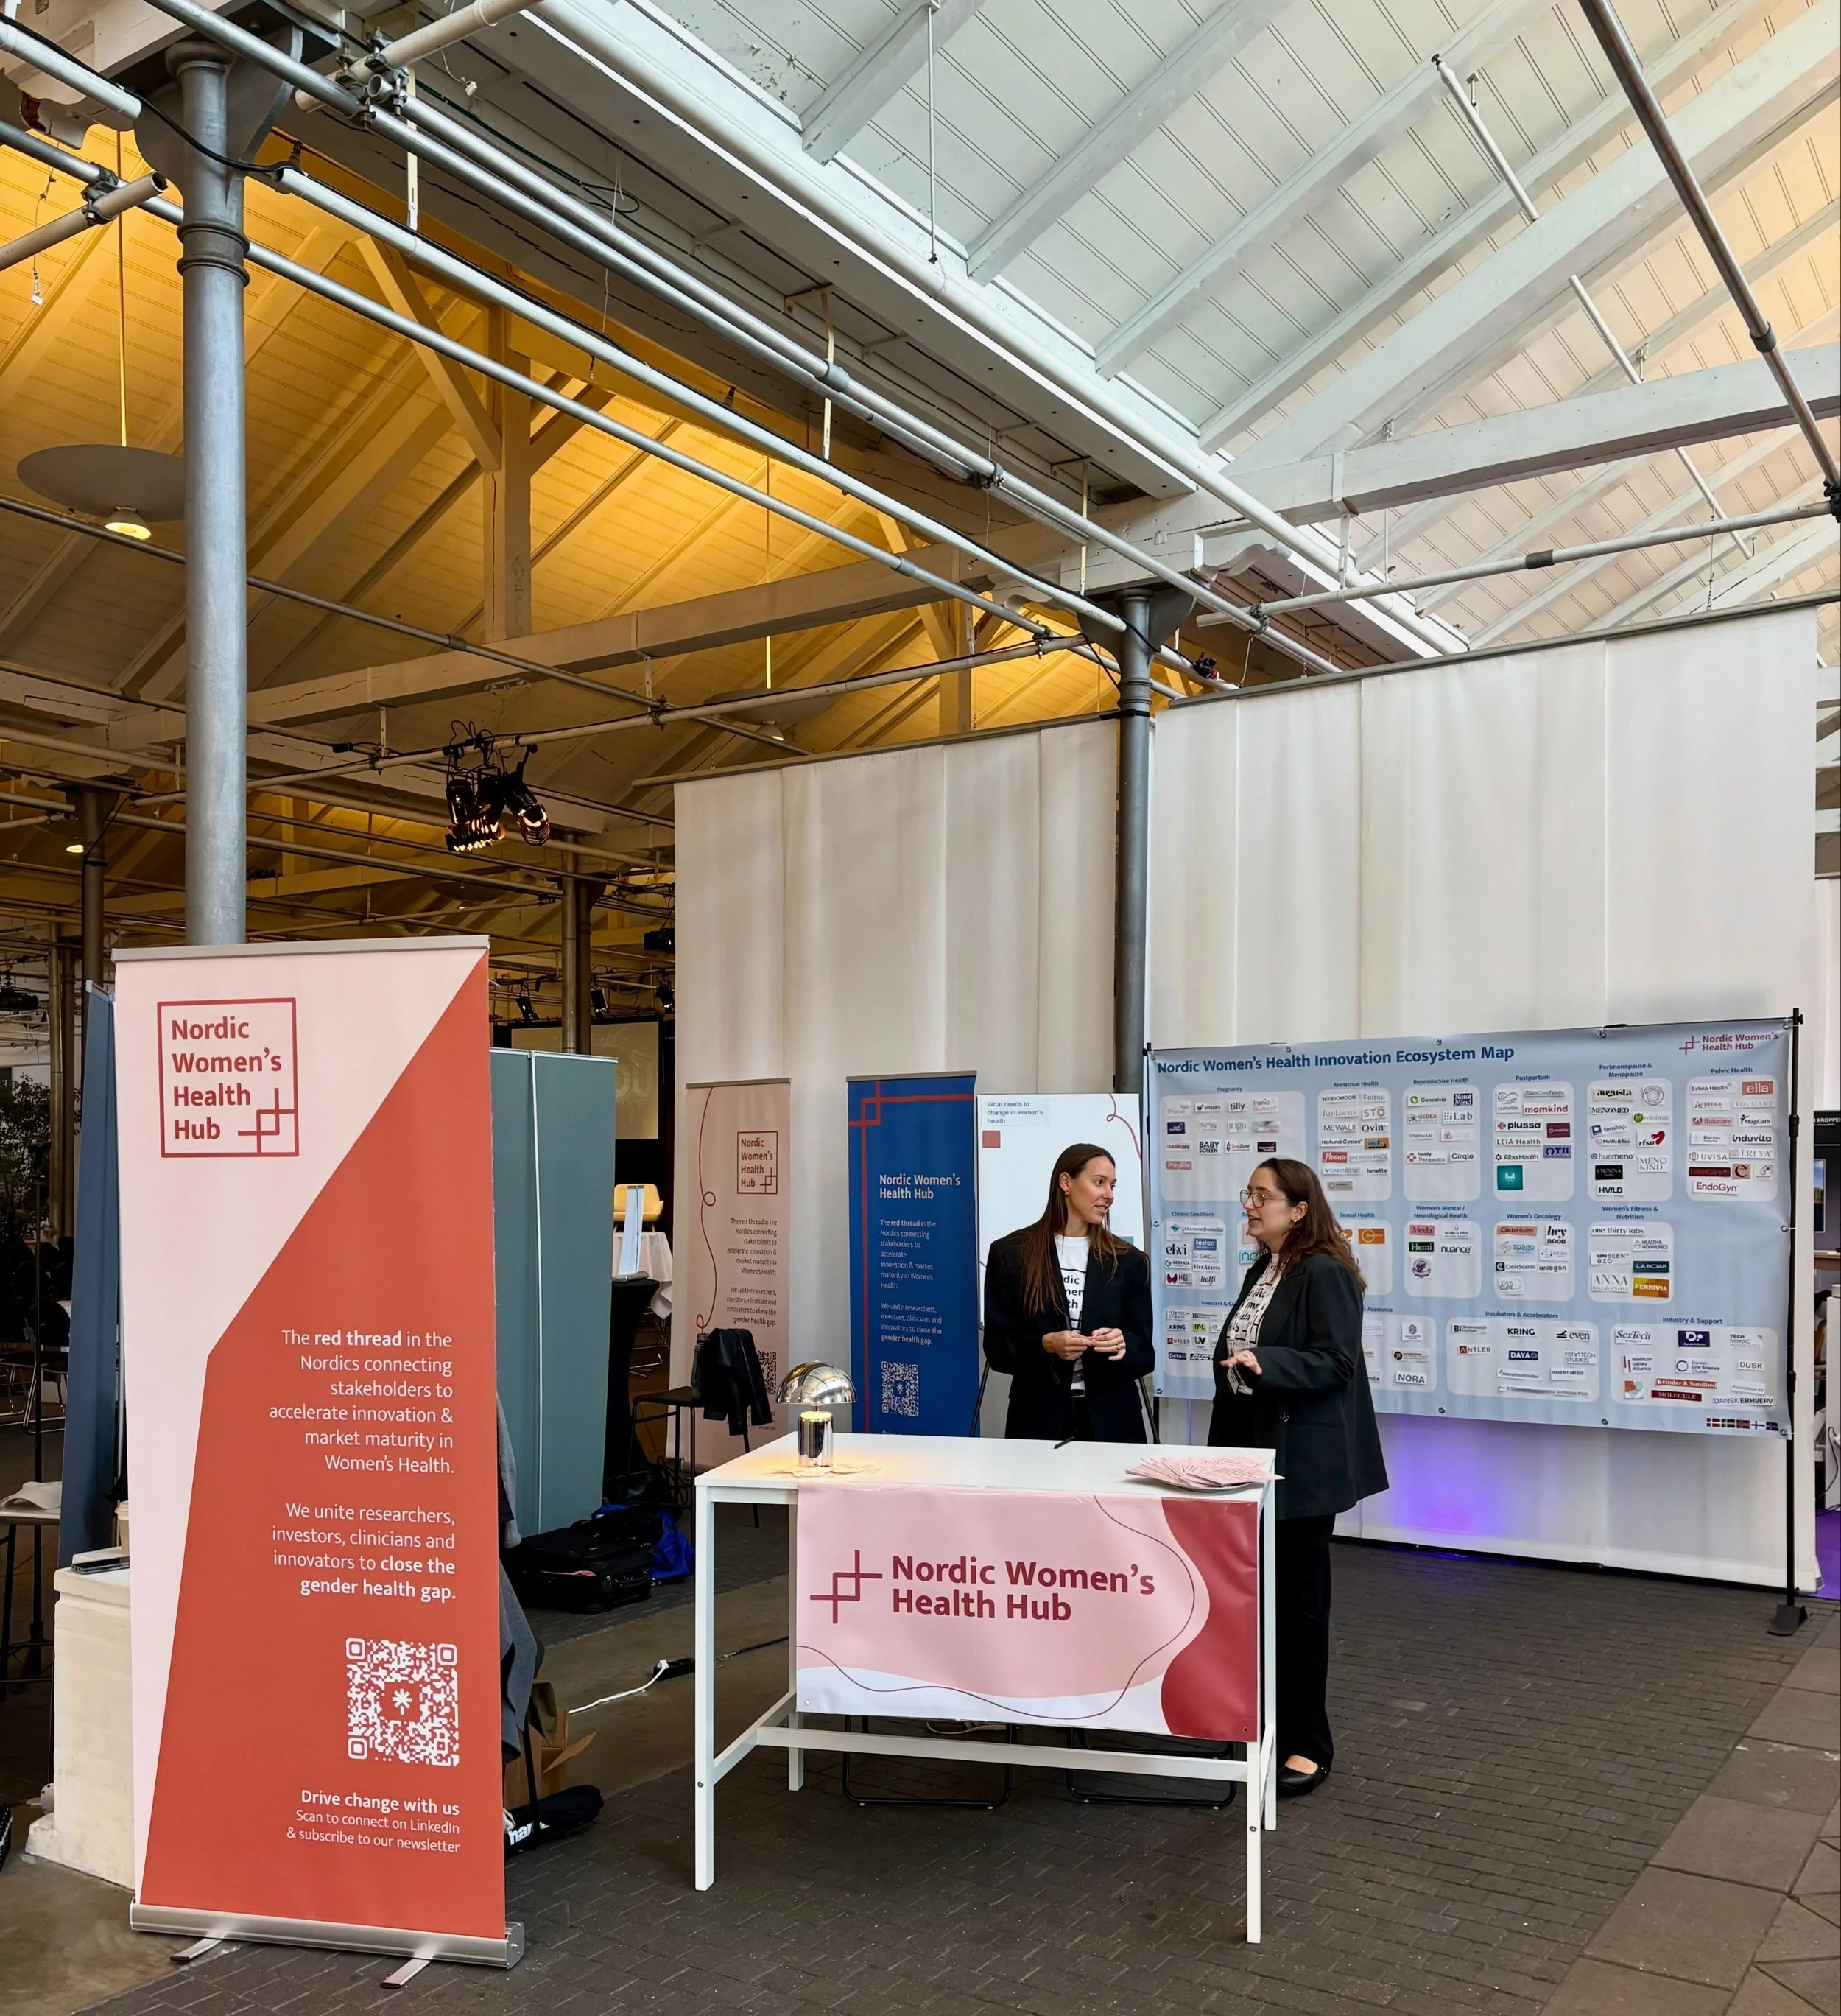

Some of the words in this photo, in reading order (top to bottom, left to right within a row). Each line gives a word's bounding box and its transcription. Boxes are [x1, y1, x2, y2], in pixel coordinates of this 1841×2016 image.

[172, 1015, 250, 1040] Nordic
[1702, 1034, 1733, 1043] Nordic
[1702, 1043, 1733, 1051] Health
[1735, 1042, 1754, 1050] Hub
[172, 1047, 282, 1073] Women’s
[1158, 1059, 1200, 1074] Nordic
[1203, 1056, 1262, 1072] Women’s
[1266, 1054, 1311, 1069] Health
[1314, 1050, 1392, 1067] Innovation
[1396, 1048, 1476, 1066] Ecosystem
[1481, 1047, 1515, 1062] Map
[1413, 1078, 1449, 1086] Reproductive
[174, 1082, 251, 1106] Health
[1747, 1083, 1769, 1094] ella
[1364, 1106, 1385, 1117] STÖ
[1524, 1104, 1569, 1114] momkind
[175, 1116, 221, 1140] Hub
[741, 1137, 764, 1148] Nordic
[1732, 1134, 1772, 1142] induvita
[741, 1165, 764, 1175] Health
[741, 1177, 756, 1188] Hub
[880, 1174, 911, 1186] Nordic
[913, 1173, 961, 1186] Women’s
[880, 1187, 911, 1199] Health
[915, 1187, 934, 1199] Hub
[1414, 1212, 1448, 1221] Neurological
[901, 1219, 921, 1227] thread
[926, 1220, 936, 1228] the
[900, 1230, 930, 1240] connecting
[1411, 1243, 1433, 1251] Hemi
[1513, 1244, 1535, 1252] spago
[1662, 1316, 1689, 1324] Industry
[1696, 1317, 1723, 1325] Support
[1507, 1327, 1535, 1335] KRING
[1569, 1332, 1590, 1340] even
[282, 1329, 310, 1345] The
[315, 1330, 342, 1346] red
[346, 1330, 402, 1346] thread
[407, 1331, 420, 1347] in
[425, 1332, 452, 1348] the
[881, 1334, 901, 1342] gender
[901, 1334, 919, 1344] health
[921, 1337, 933, 1346] gap.
[300, 1354, 360, 1371] Nordics
[364, 1357, 453, 1377] connecting
[1739, 1361, 1763, 1369] DUSK
[1398, 1374, 1425, 1383] NORA
[1689, 1380, 1718, 1388] Sundhed
[331, 1379, 432, 1397] stakeholders
[435, 1383, 453, 1398] to
[1658, 1391, 1697, 1400] MOLECULE
[270, 1403, 348, 1421] accelerate
[353, 1406, 436, 1423] innovation
[441, 1408, 454, 1423] &
[305, 1428, 361, 1445] market
[365, 1431, 435, 1453] maturity
[440, 1433, 453, 1448] in
[324, 1455, 394, 1472] Women’s
[398, 1456, 454, 1474] Health.
[286, 1503, 310, 1518] We
[315, 1503, 355, 1520] unite
[359, 1506, 455, 1526] researchers,
[272, 1526, 346, 1547] investors,
[350, 1528, 421, 1548] clinicians
[426, 1533, 455, 1549] and
[274, 1551, 355, 1570] innovators
[359, 1555, 376, 1570] to
[380, 1555, 423, 1573] close
[427, 1556, 456, 1575] the
[893, 1555, 996, 1585] Nordic
[1004, 1560, 1155, 1595] Women’s
[300, 1577, 359, 1596] gender
[364, 1578, 416, 1598] health
[420, 1586, 456, 1604] gap.
[893, 1588, 996, 1618] Health
[1007, 1592, 1071, 1621] Hub
[301, 1790, 341, 1806] Drive
[345, 1793, 400, 1814] change
[404, 1797, 437, 1814] with
[443, 1804, 460, 1816] us
[296, 1810, 323, 1823] Scan
[326, 1813, 339, 1824] to
[342, 1816, 389, 1828] connect
[392, 1821, 406, 1830] on
[410, 1819, 460, 1834] LinkedIn
[286, 1827, 296, 1838] &
[299, 1827, 355, 1844] subscribe
[358, 1833, 370, 1845] to
[373, 1836, 394, 1847] our
[396, 1838, 460, 1852] newsletter
